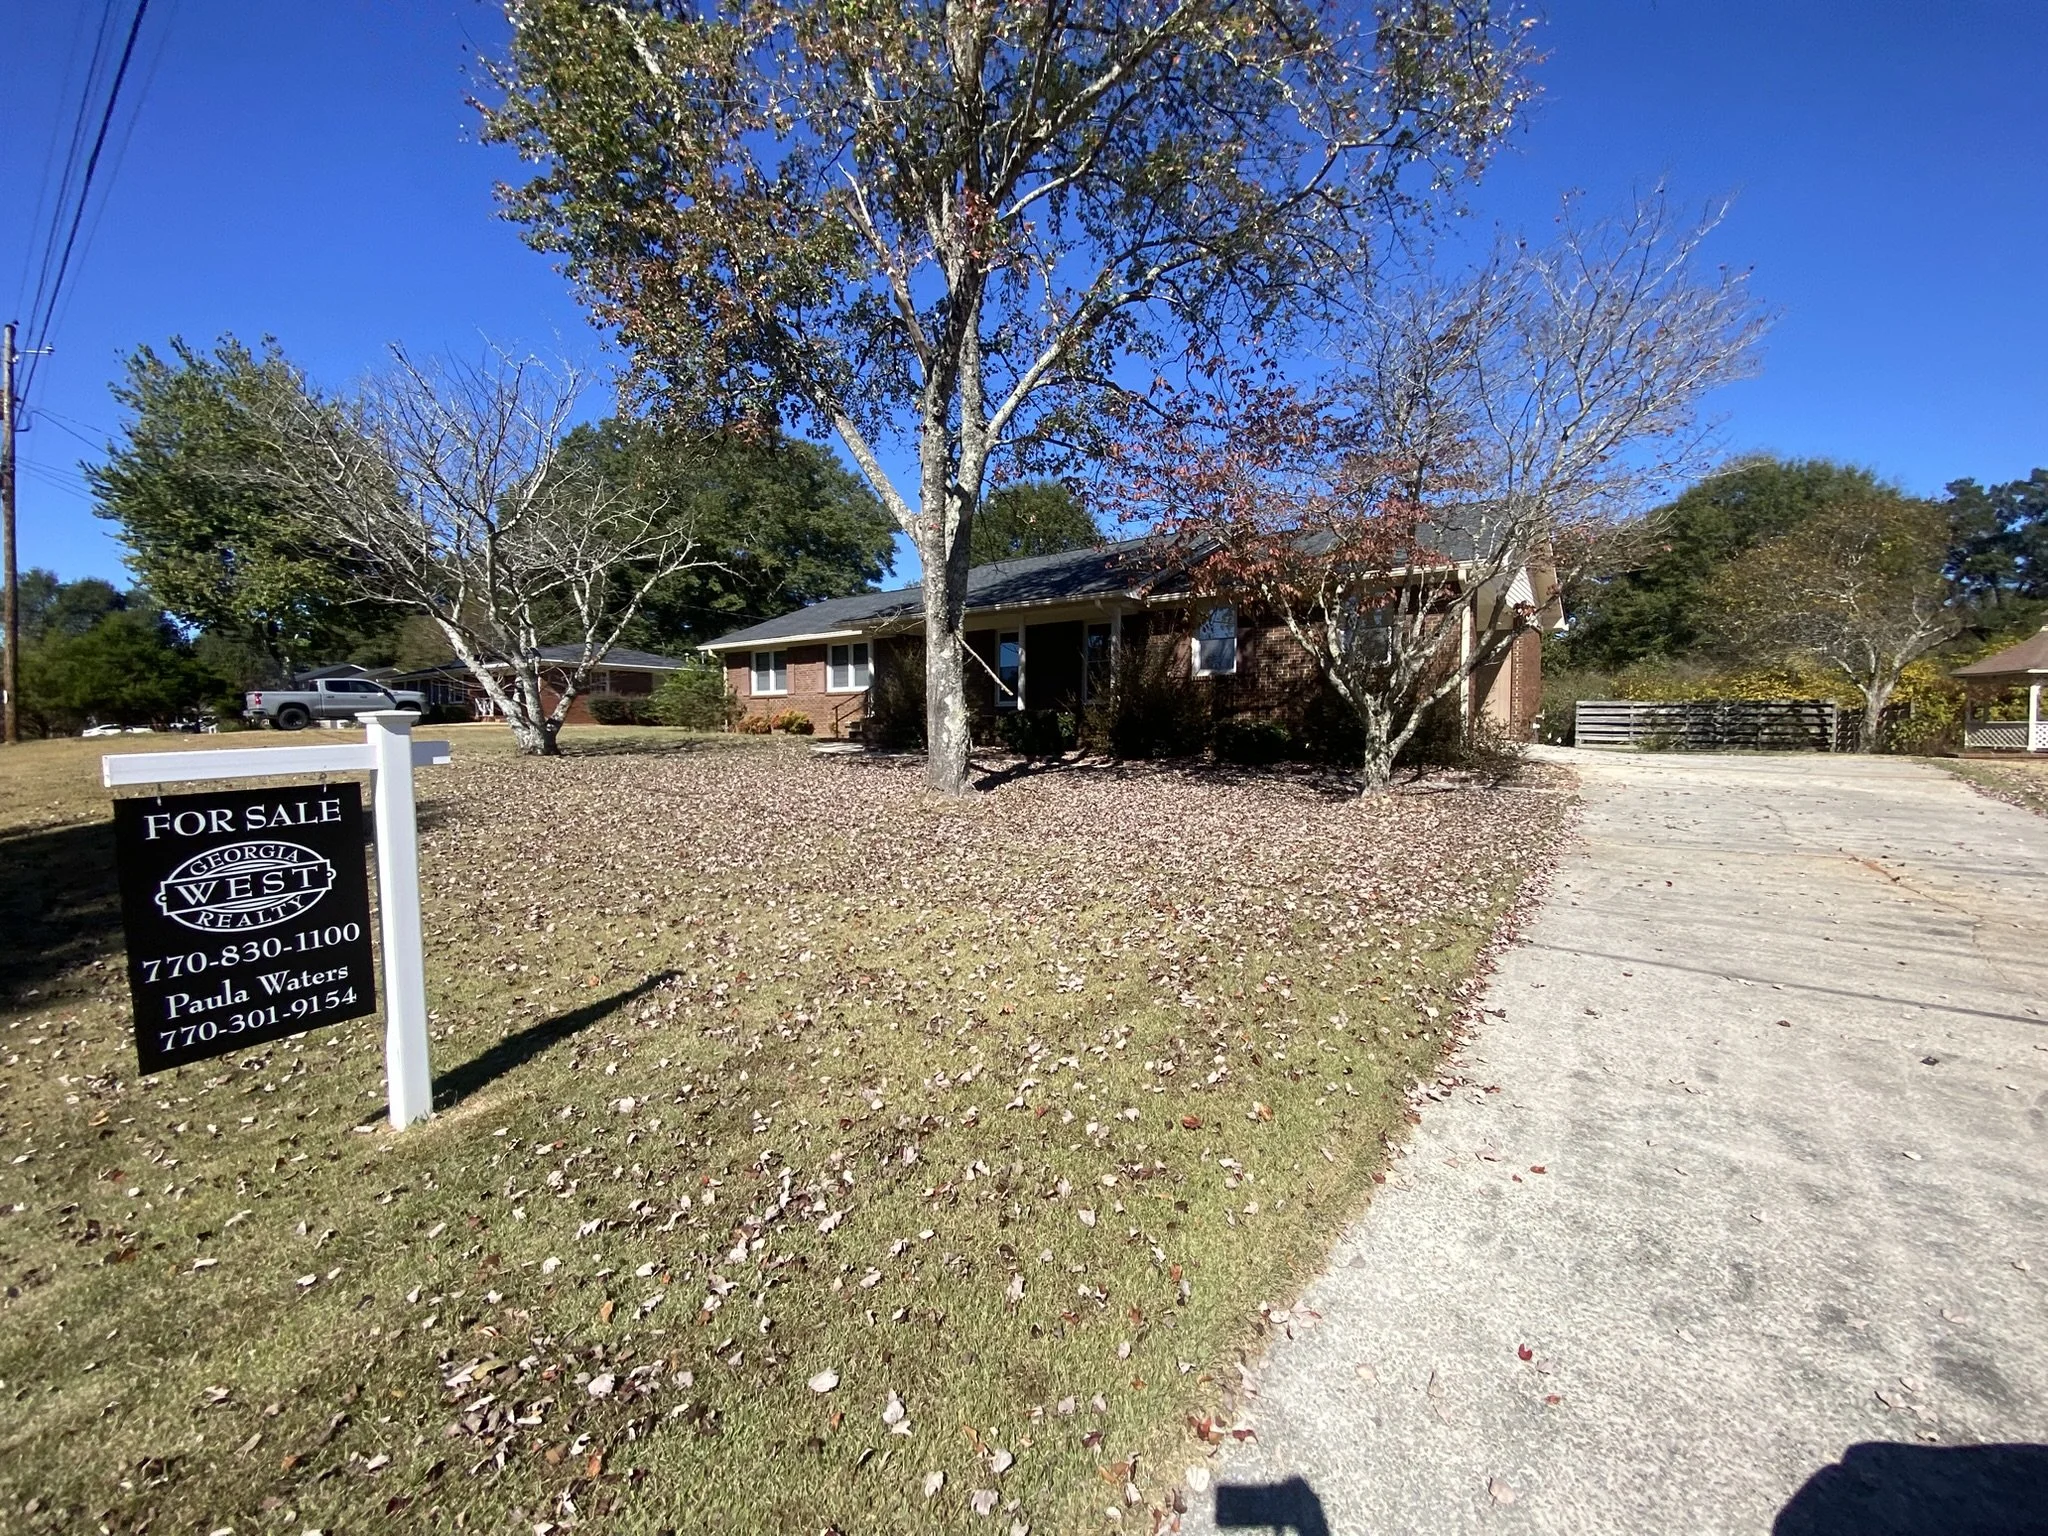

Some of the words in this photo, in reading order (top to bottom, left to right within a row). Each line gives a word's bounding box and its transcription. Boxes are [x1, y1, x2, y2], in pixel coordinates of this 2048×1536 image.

[144, 809, 236, 840] FOR
[245, 799, 341, 831] SALE
[189, 845, 299, 876] GEORGIA
[175, 866, 318, 906] WEST
[197, 896, 305, 928] REALTY
[142, 922, 360, 984] 770-830-1100
[165, 979, 250, 1019] Paula
[257, 965, 349, 996] Waters
[160, 986, 357, 1052] 770-301-9154
